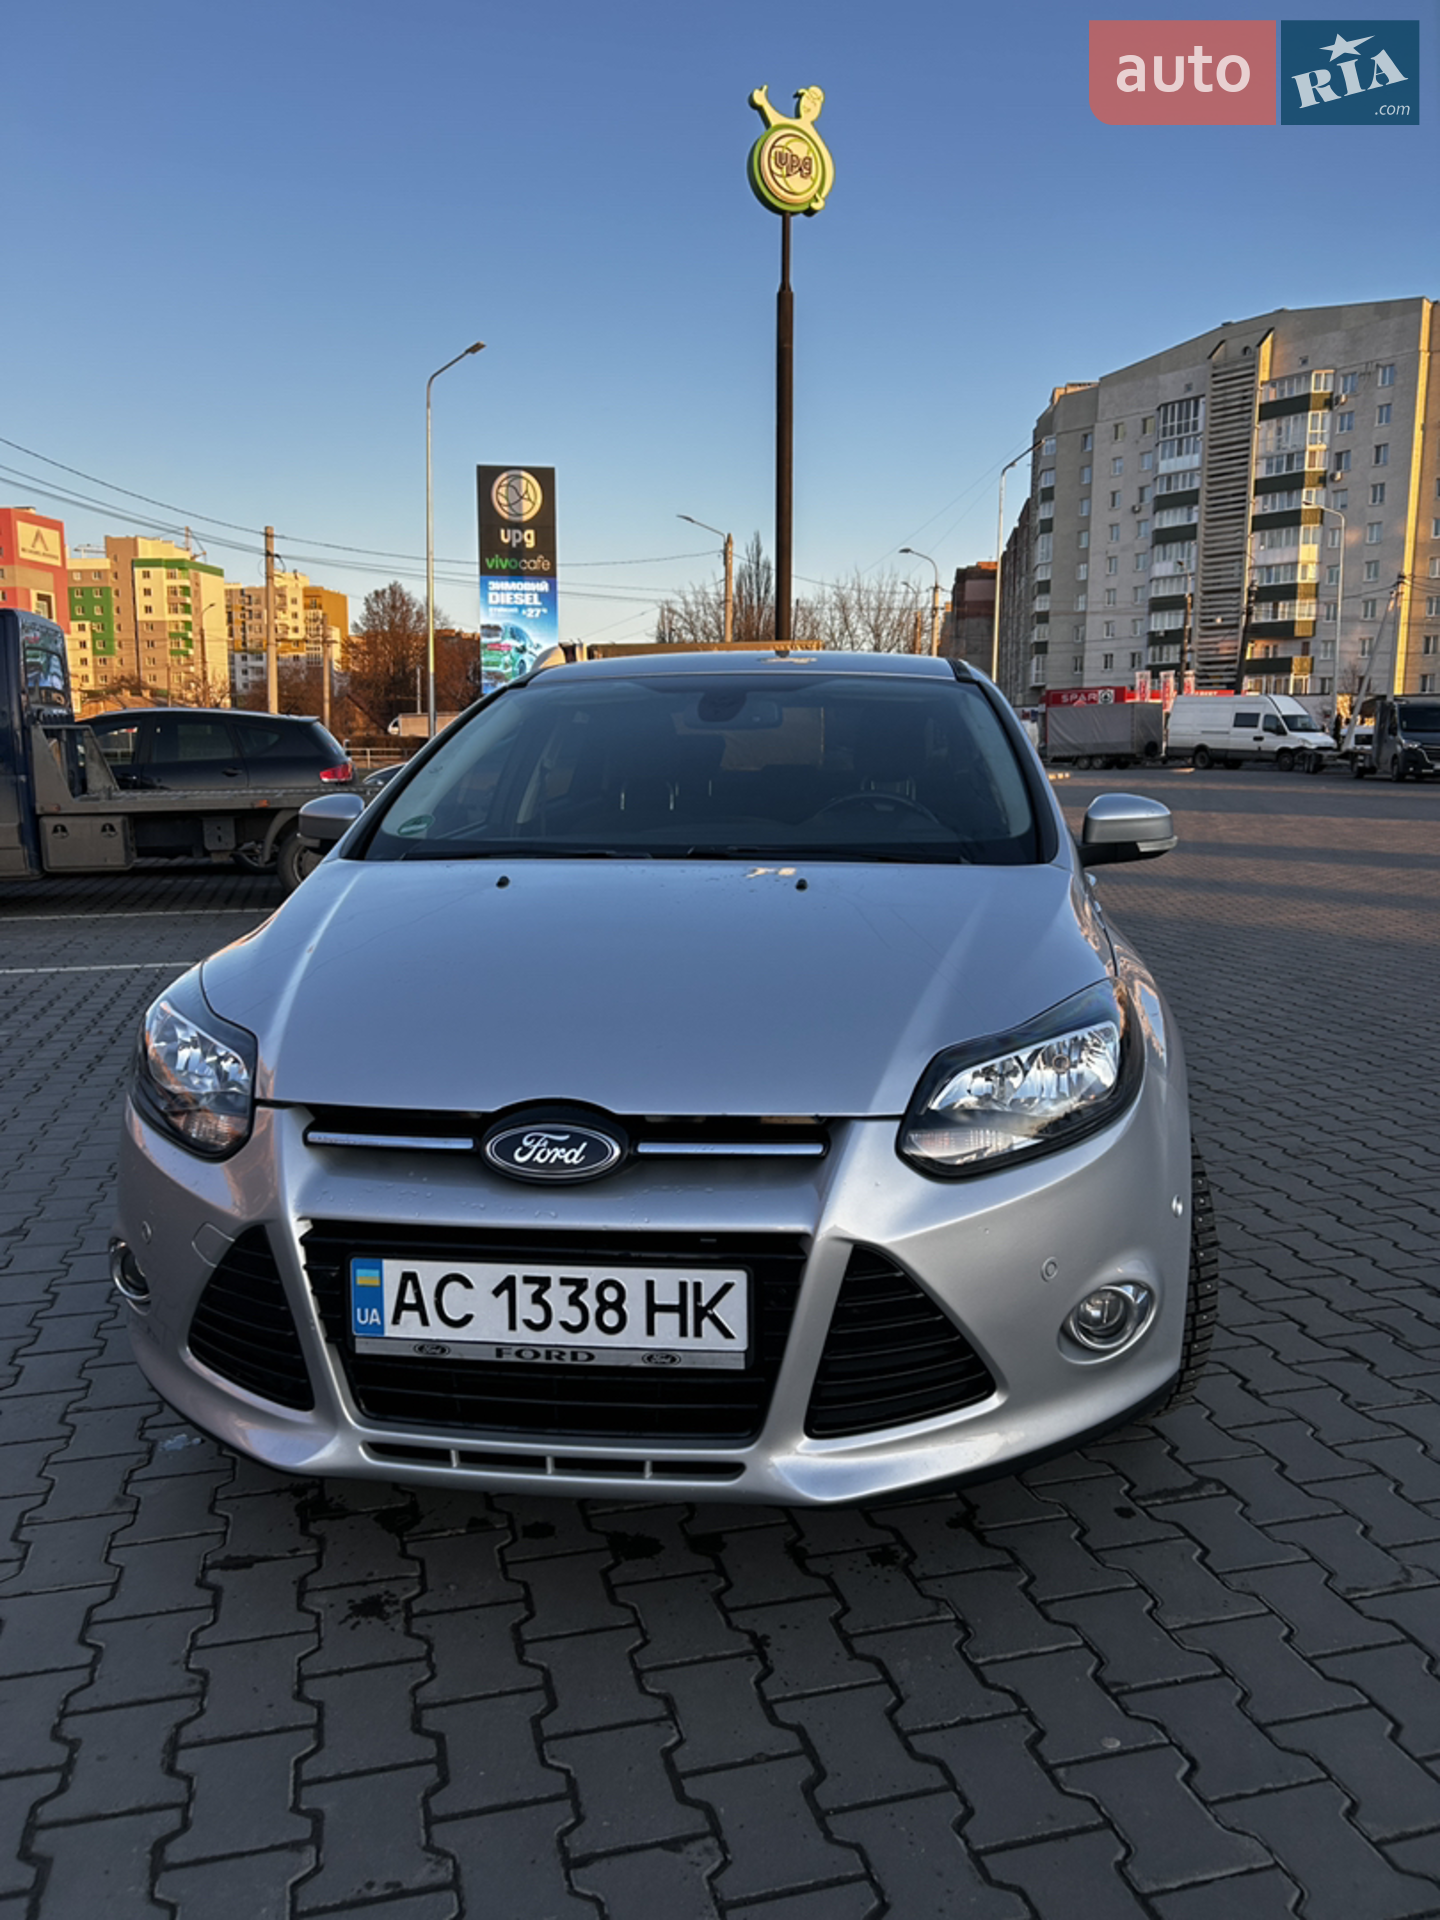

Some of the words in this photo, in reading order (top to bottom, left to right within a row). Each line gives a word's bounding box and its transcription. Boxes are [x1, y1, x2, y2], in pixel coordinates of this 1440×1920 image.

[774, 151, 812, 179] upg
[500, 528, 535, 548] upg
[488, 593, 542, 605] DIESEL
[1061, 692, 1098, 703] SPAR
[513, 1132, 588, 1165] Ford
[391, 1270, 475, 1328] AC
[491, 1274, 628, 1336] 1338
[645, 1279, 737, 1340] HK
[356, 1307, 382, 1326] UA
[495, 1346, 596, 1363] FORD
